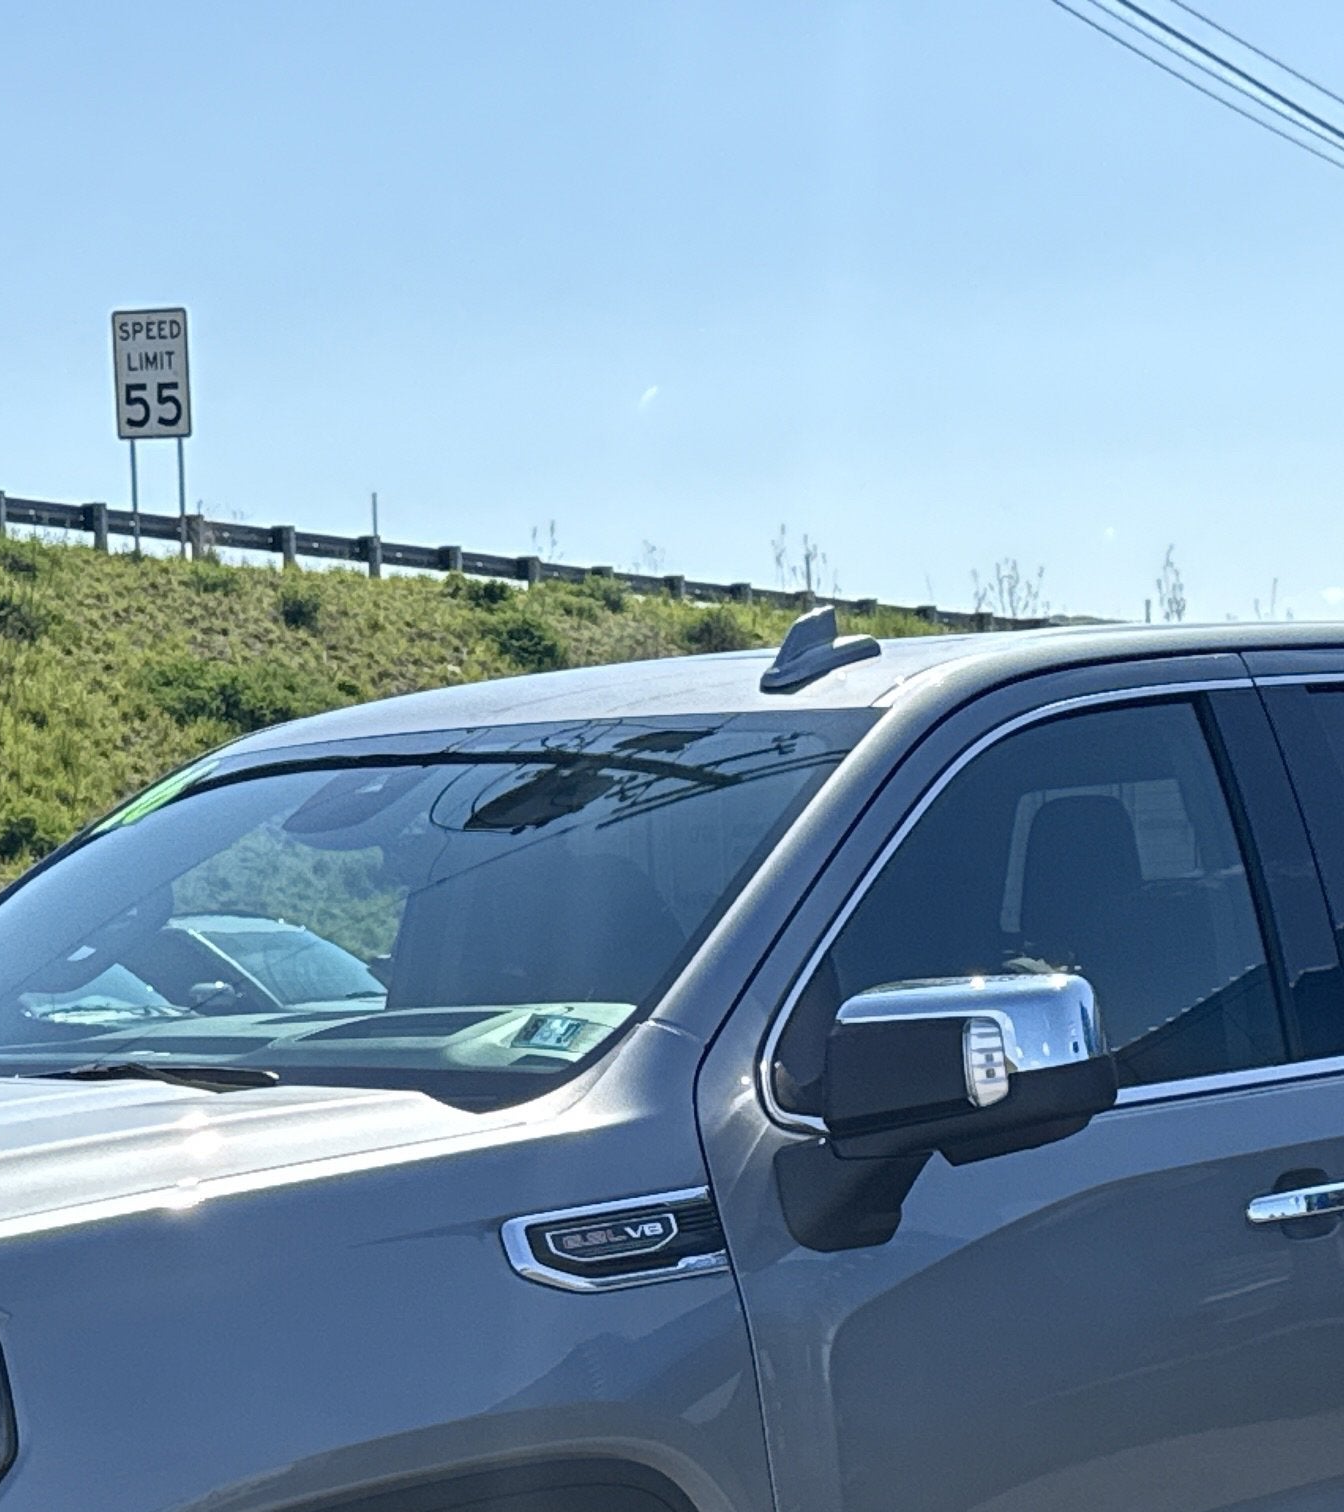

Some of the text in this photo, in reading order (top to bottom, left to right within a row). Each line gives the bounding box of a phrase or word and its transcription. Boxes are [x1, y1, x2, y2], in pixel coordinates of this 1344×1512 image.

[118, 319, 182, 341] SPEED
[126, 350, 175, 371] LIMIT
[125, 381, 182, 428] 55
